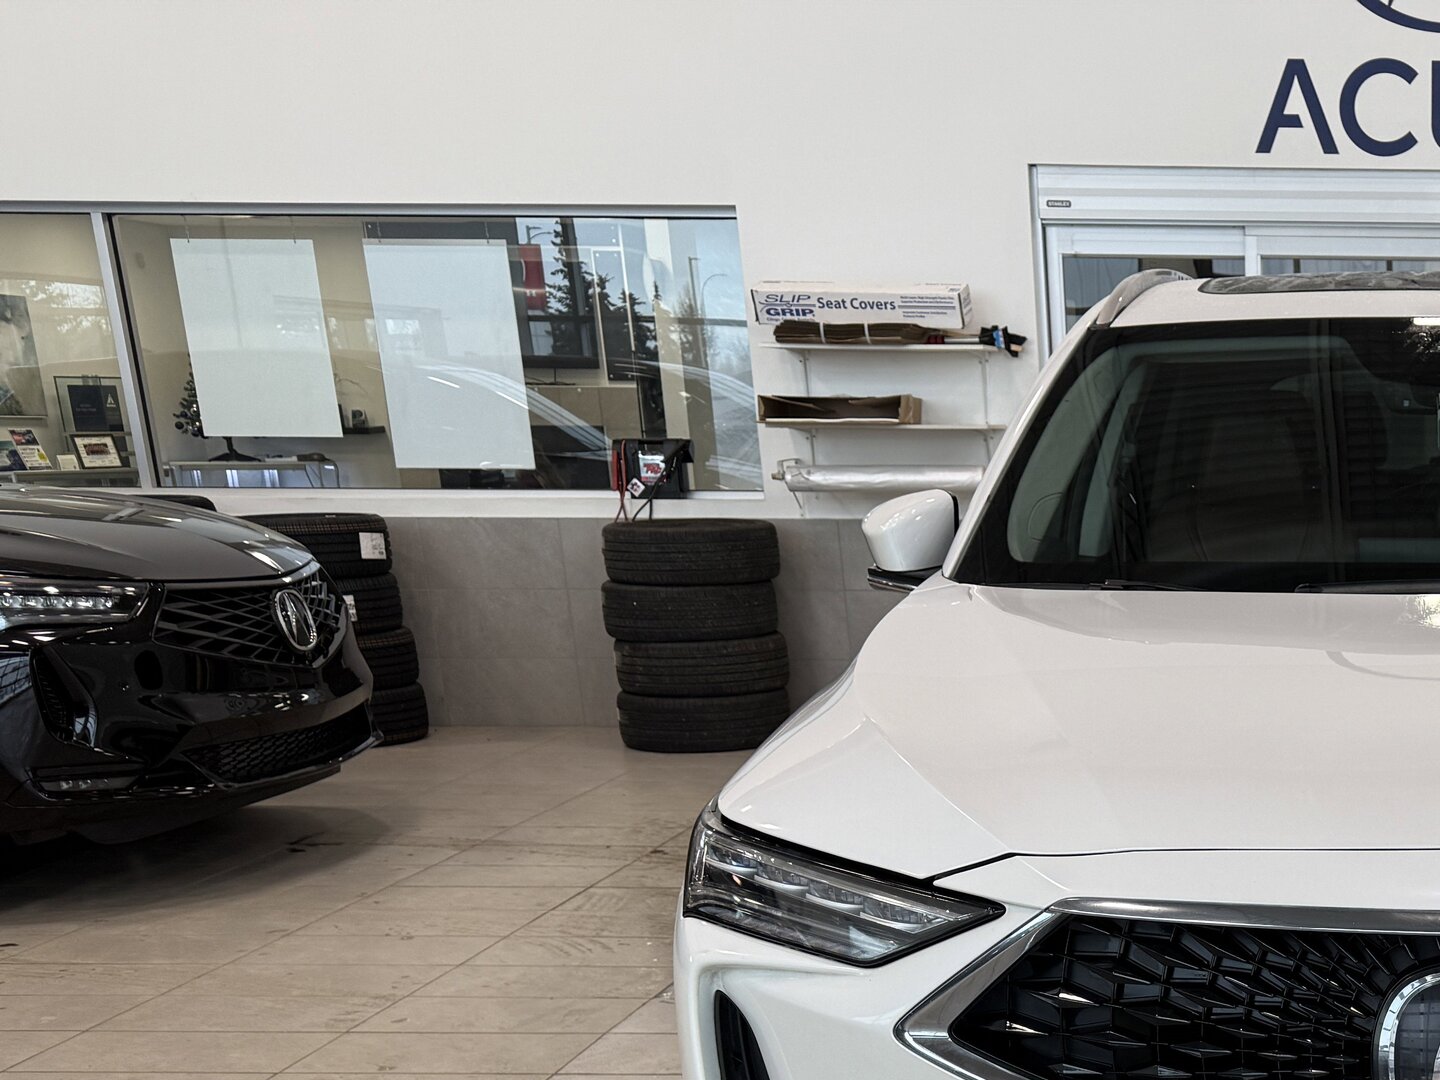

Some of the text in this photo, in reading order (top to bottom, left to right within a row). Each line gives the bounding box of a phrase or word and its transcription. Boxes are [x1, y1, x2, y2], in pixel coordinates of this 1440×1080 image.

[764, 294, 811, 303] SLIP
[816, 296, 896, 310] Seat Covers
